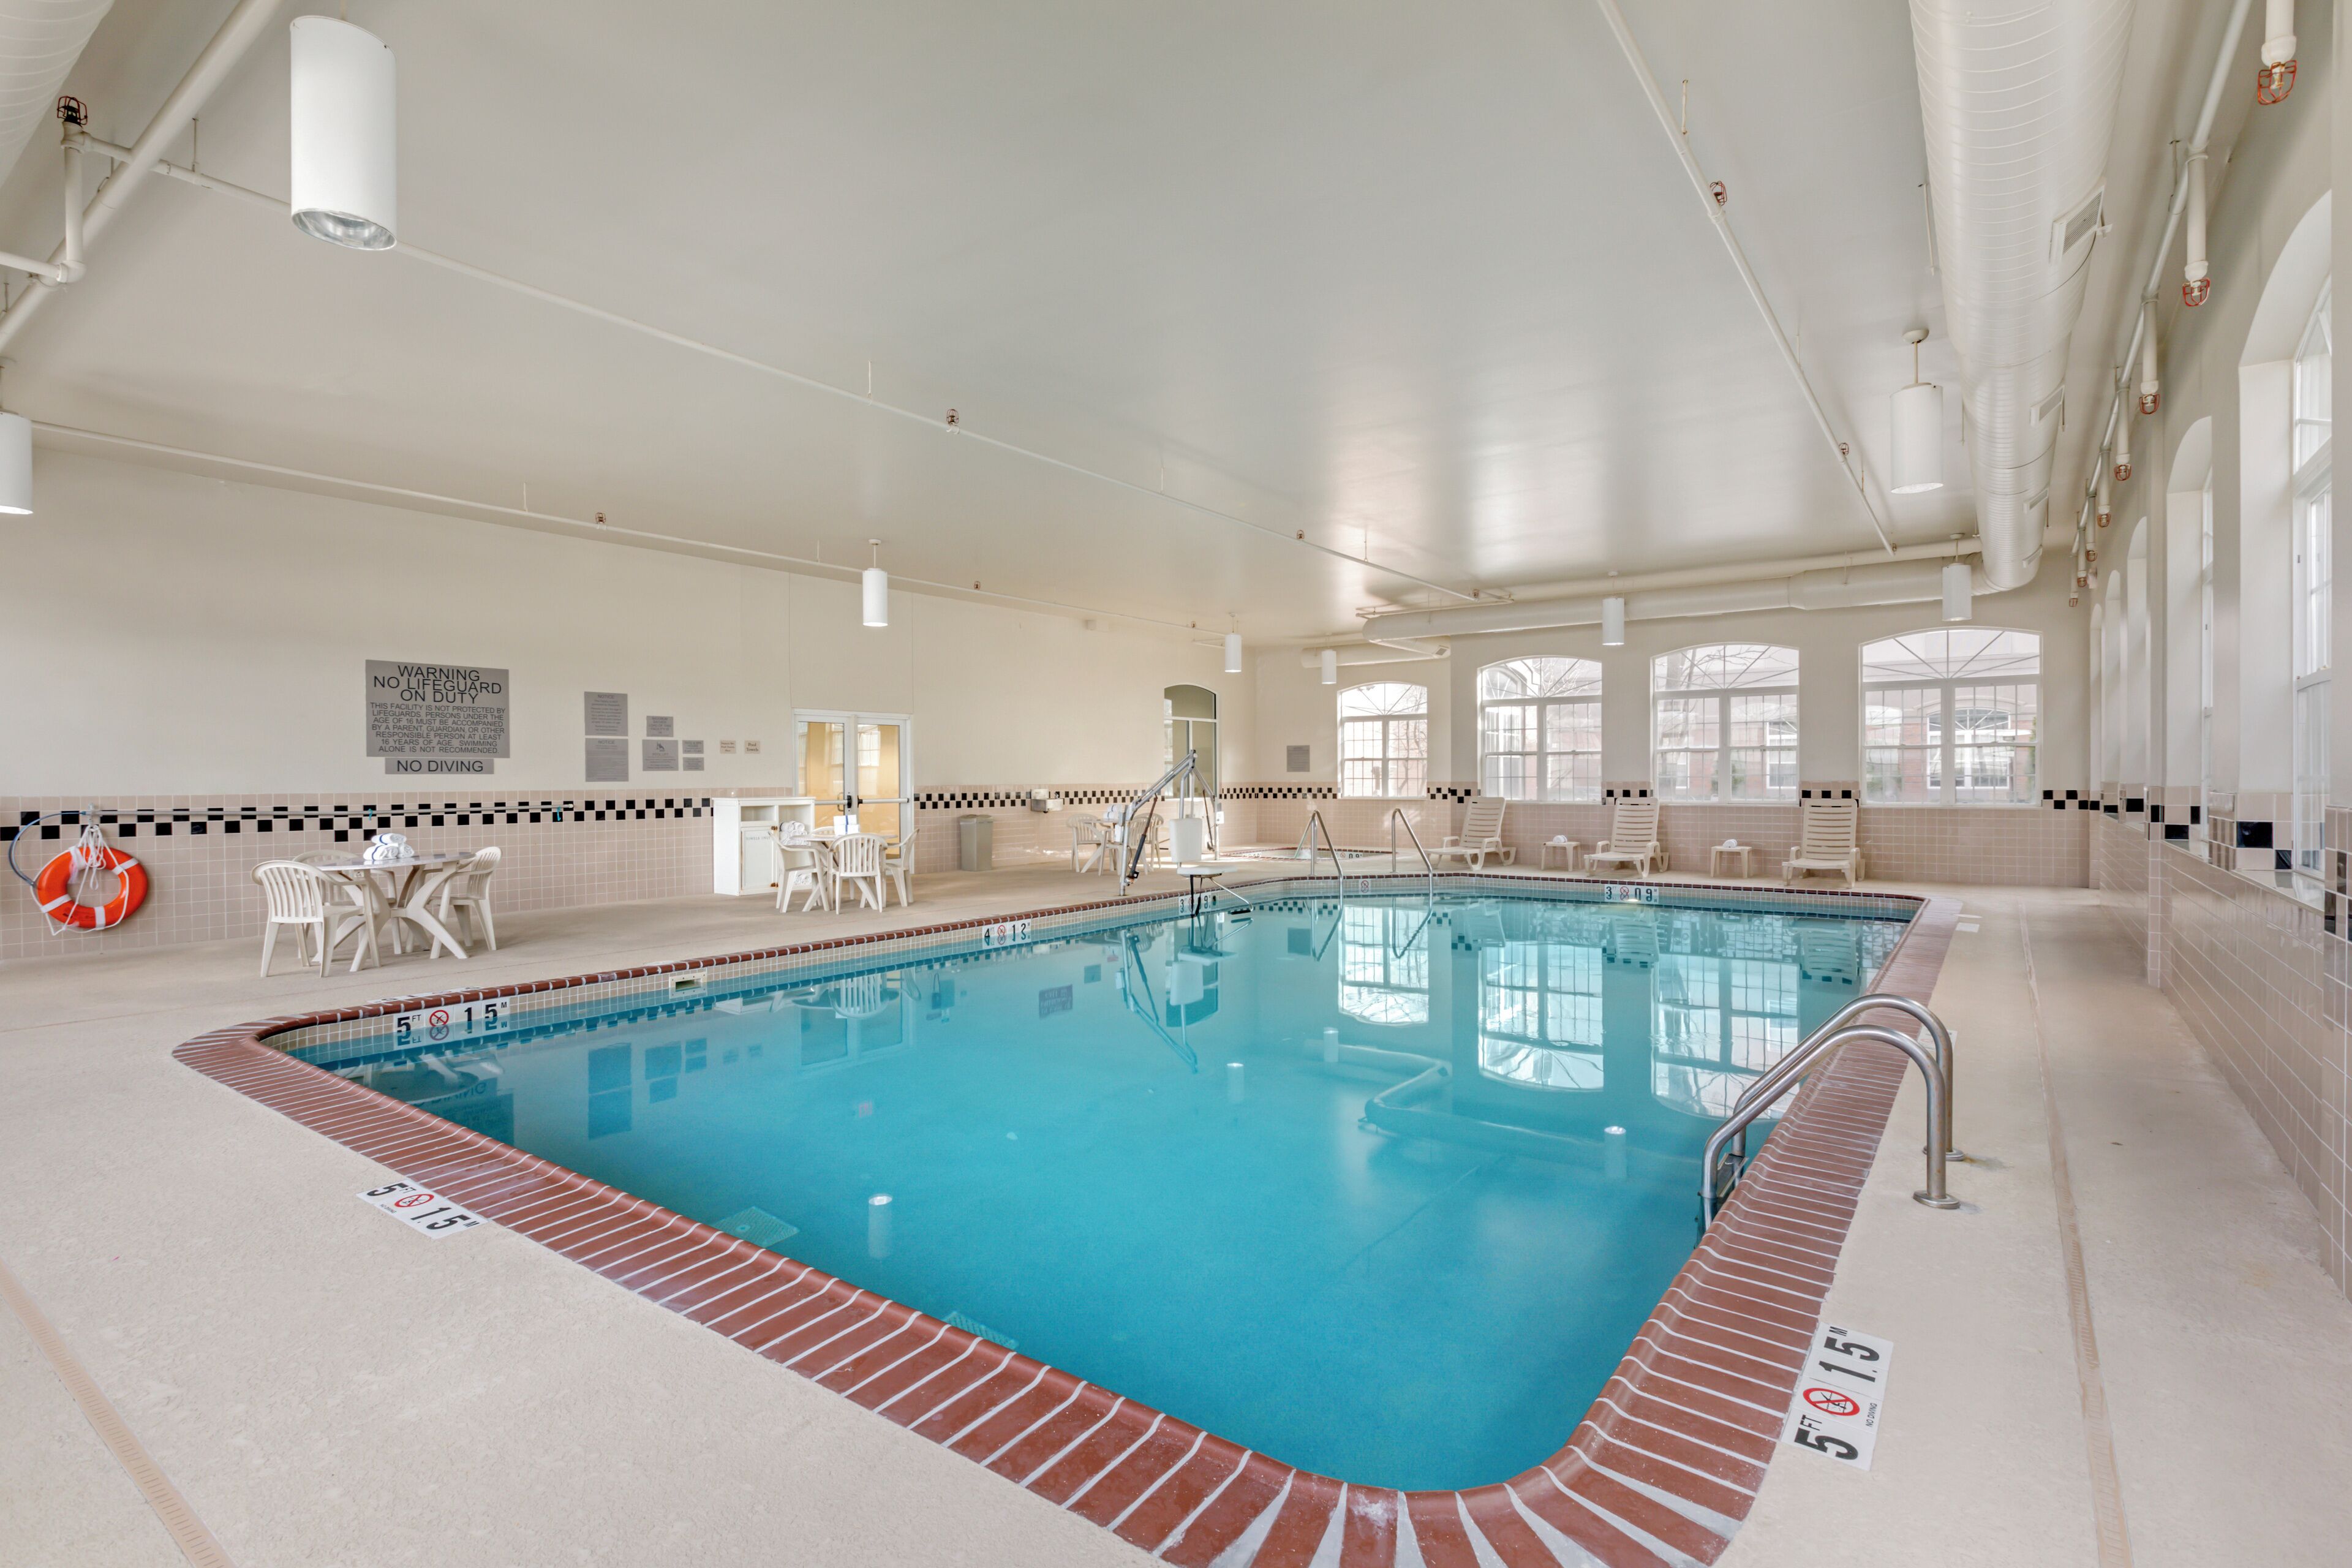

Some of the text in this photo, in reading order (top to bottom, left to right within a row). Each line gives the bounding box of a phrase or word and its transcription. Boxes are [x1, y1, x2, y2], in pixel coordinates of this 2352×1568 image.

[398, 665, 480, 681] WARNING
[374, 676, 501, 693] NO LIFEGUARD
[401, 690, 478, 704] ON DUTY
[398, 760, 483, 772] NO DIVING
[984, 929, 990, 937] 4
[397, 1016, 411, 1033] 5
[367, 1182, 409, 1196] 5
[1829, 1326, 1848, 1336] M
[1868, 1402, 1877, 1419] DIVING
[1800, 1414, 1822, 1431] FT
[1794, 1427, 1859, 1460] 5
